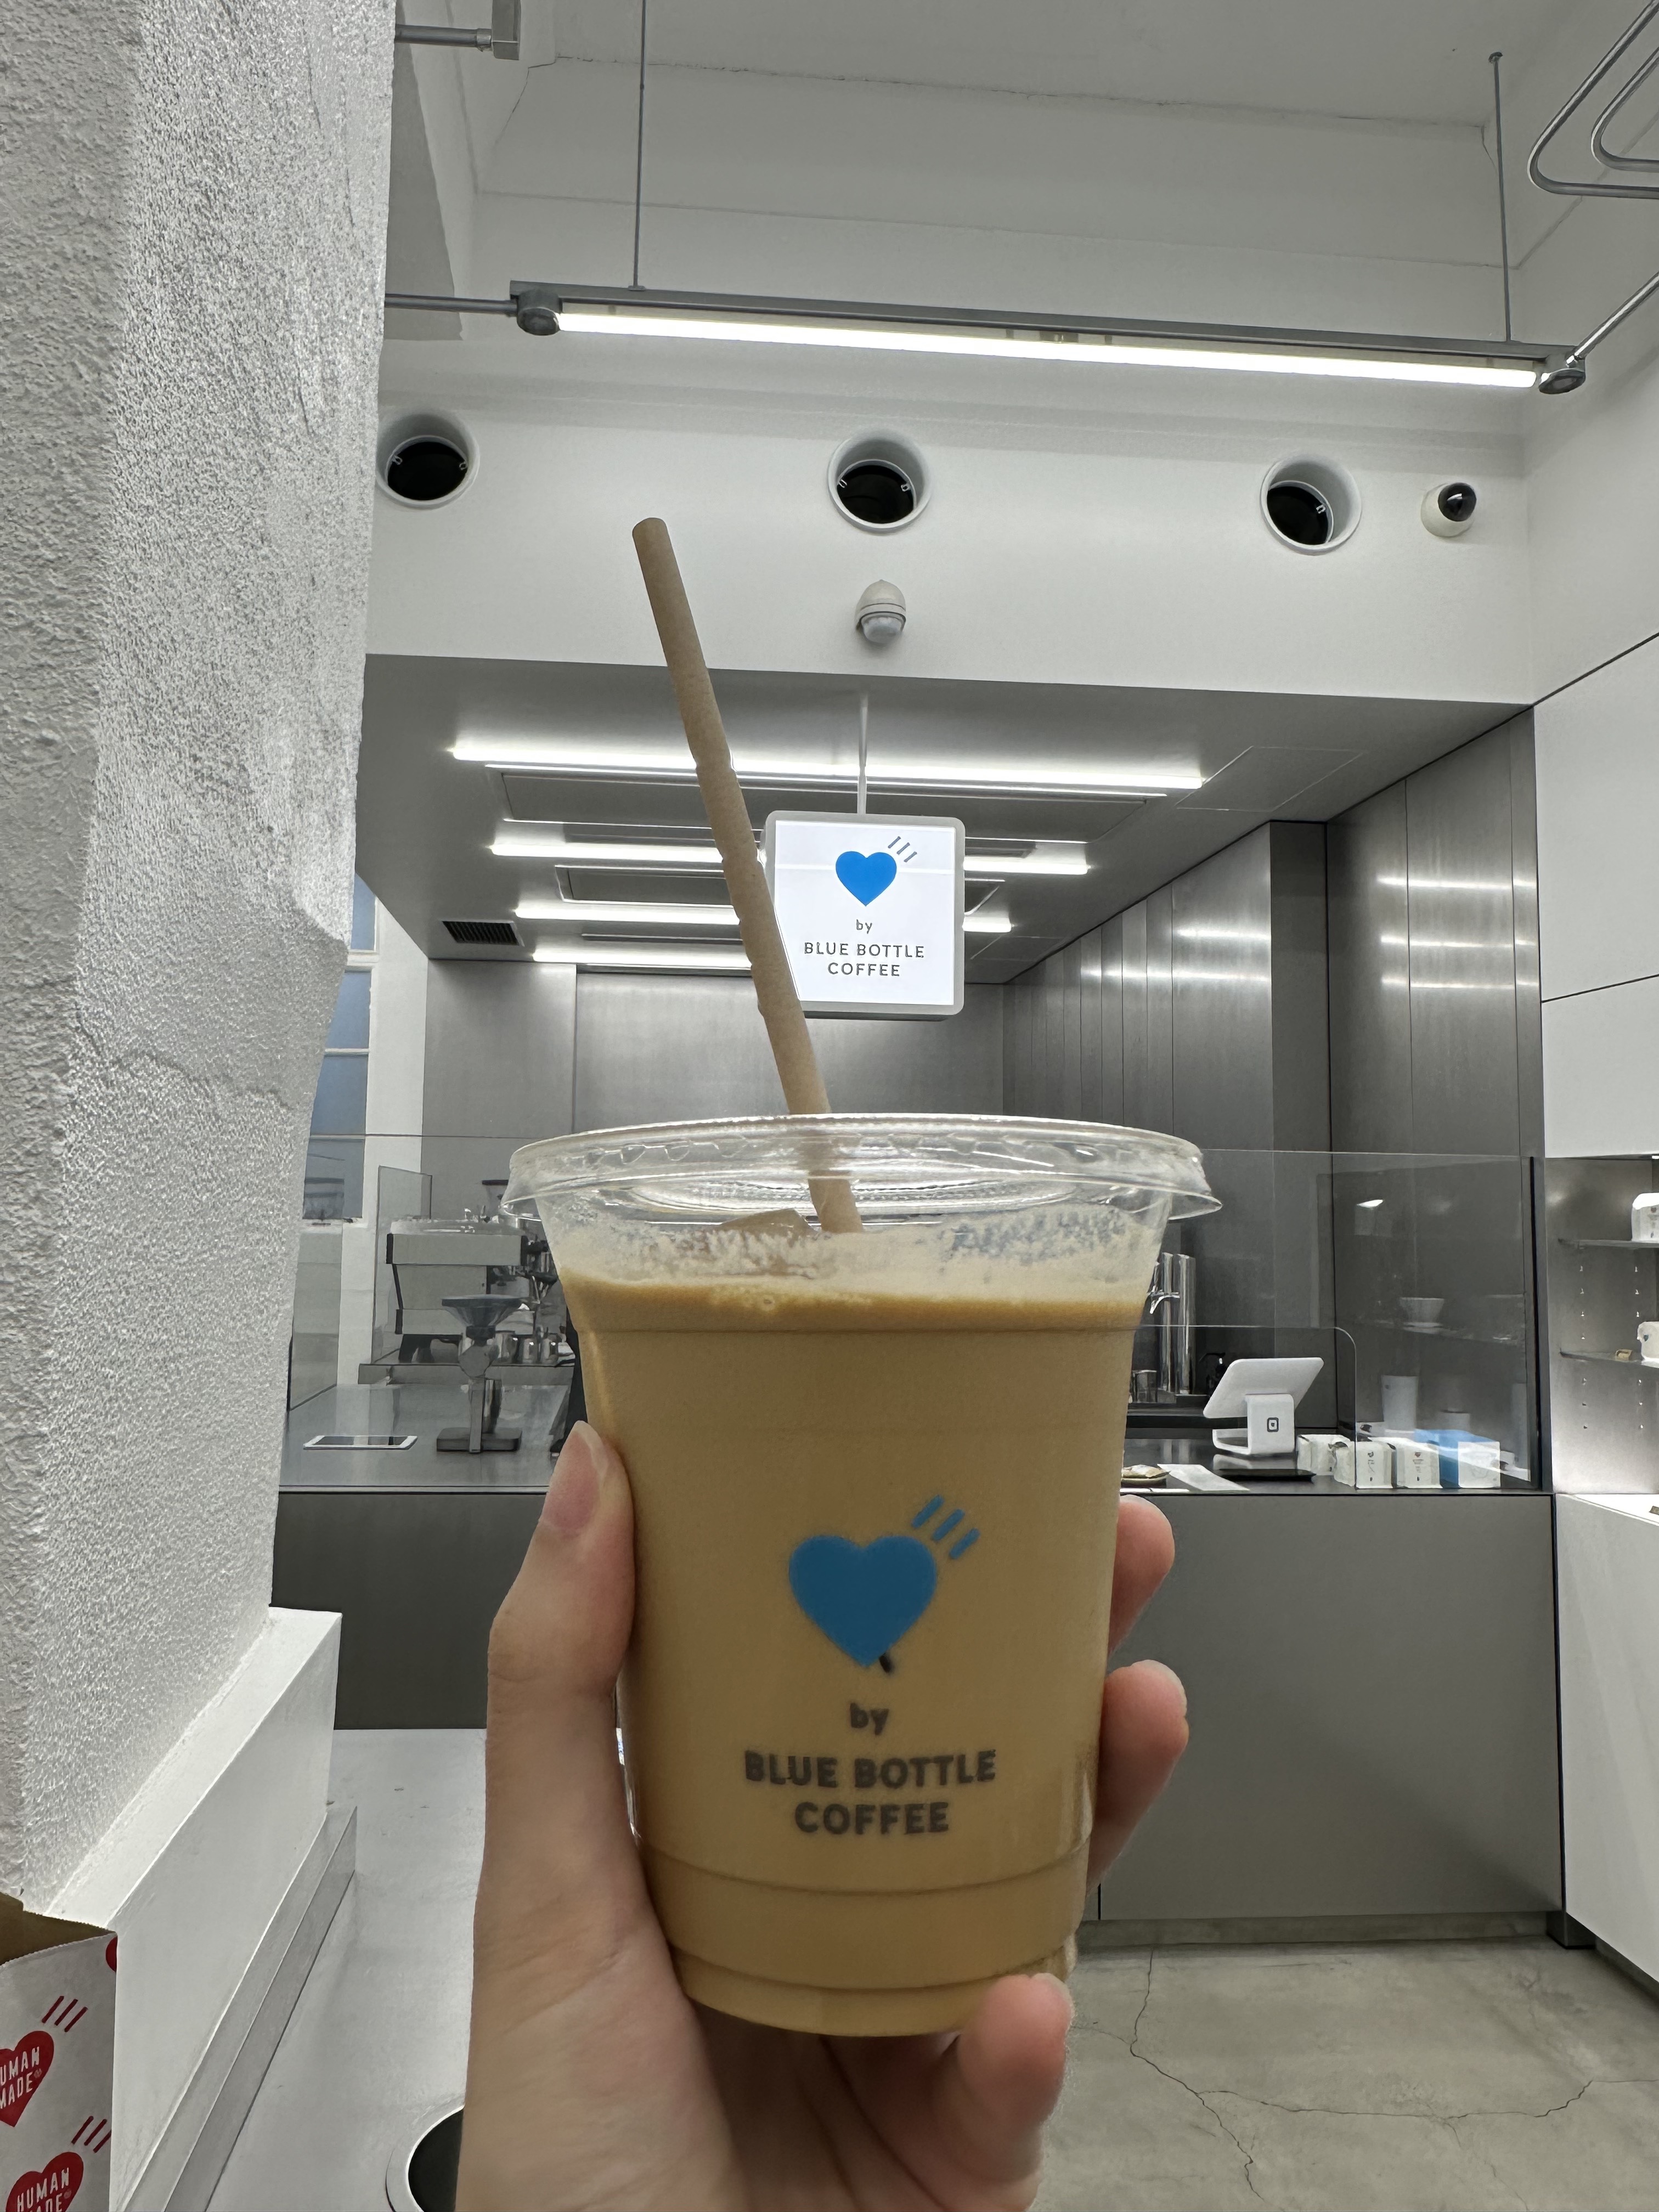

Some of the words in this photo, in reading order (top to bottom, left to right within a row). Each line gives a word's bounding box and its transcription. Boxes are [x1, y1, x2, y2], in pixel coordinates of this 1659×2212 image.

[856, 919, 872, 934] by
[804, 942, 849, 956] BLUE
[857, 944, 924, 958] BOTTLE
[828, 962, 900, 977] COFFEE
[849, 1702, 889, 1736] by
[744, 1750, 839, 1788] BLUE
[854, 1749, 996, 1789] BOTTLE
[794, 1802, 949, 1835] COFFEE
[0, 2046, 40, 2086] UMAN
[17, 2167, 69, 2212] HUMAN
